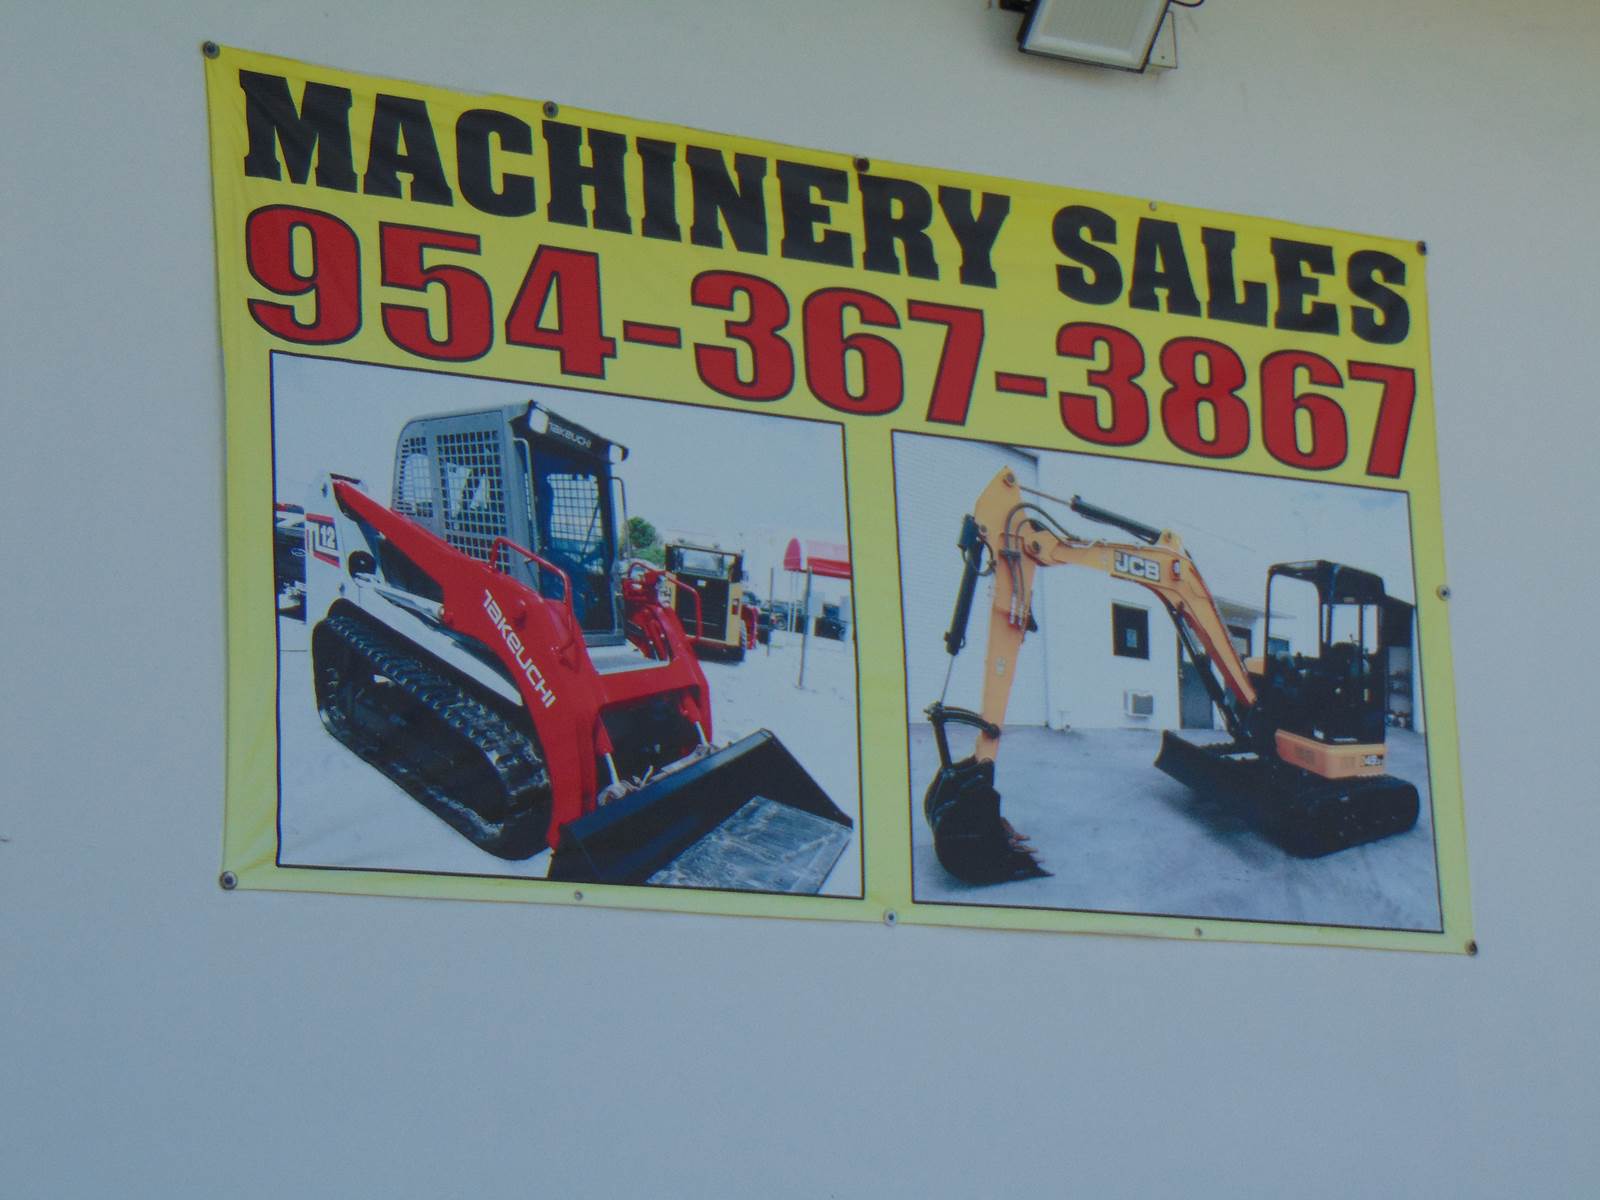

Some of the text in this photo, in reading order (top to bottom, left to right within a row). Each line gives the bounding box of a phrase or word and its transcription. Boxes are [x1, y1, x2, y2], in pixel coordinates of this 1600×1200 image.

[238, 68, 1411, 344] MACHINERY SALES
[245, 203, 1416, 479] 954-367-3867
[1114, 551, 1160, 581] JCB
